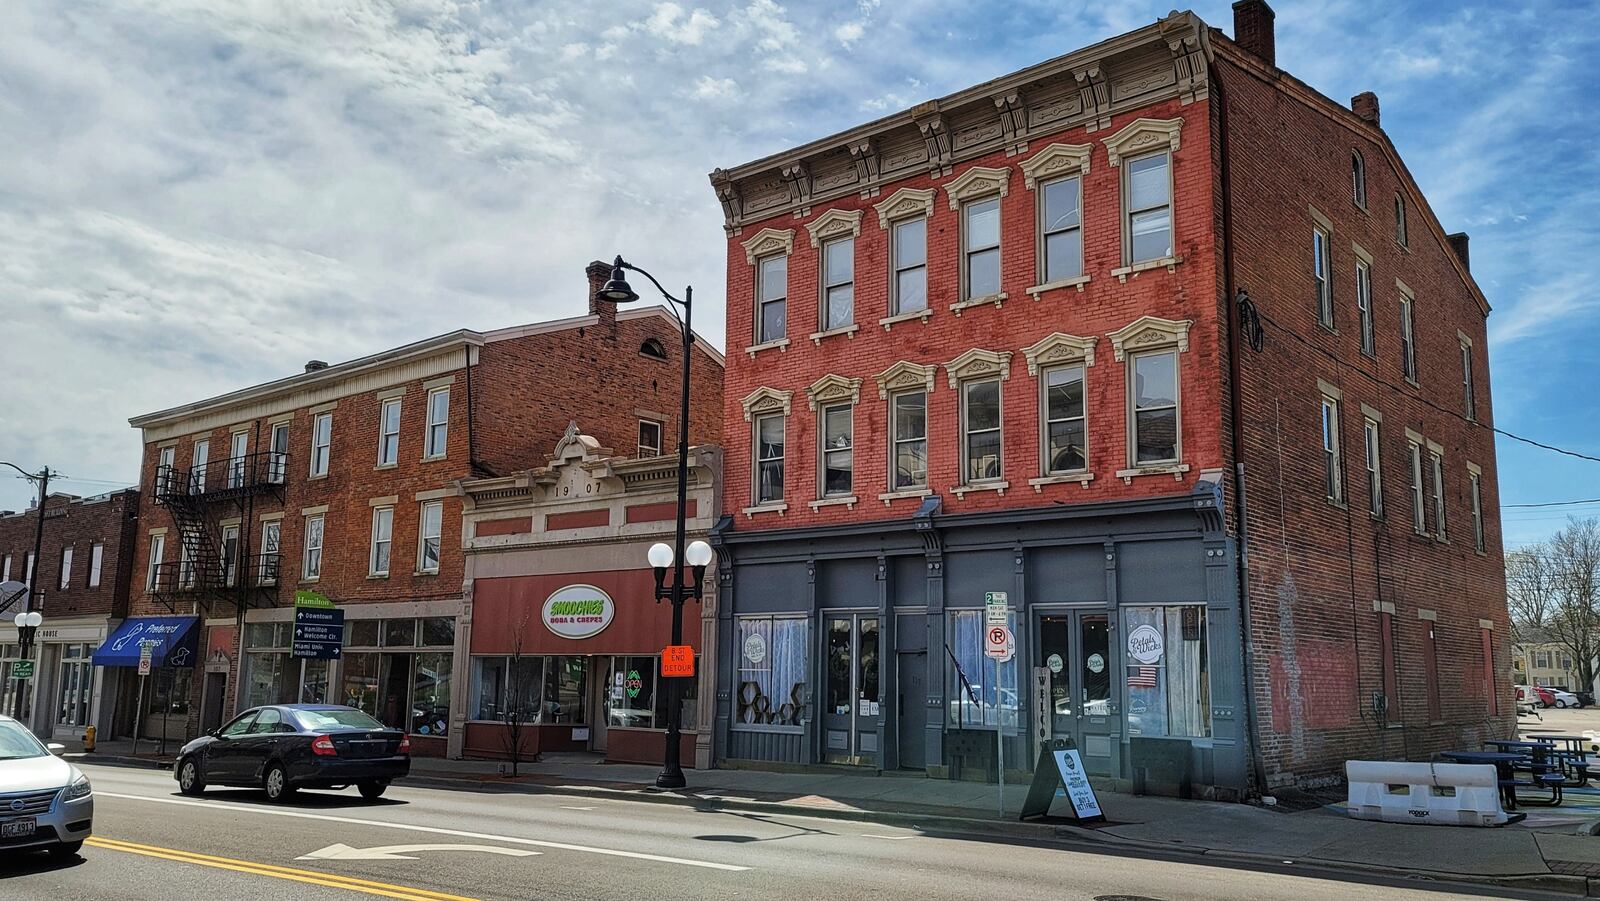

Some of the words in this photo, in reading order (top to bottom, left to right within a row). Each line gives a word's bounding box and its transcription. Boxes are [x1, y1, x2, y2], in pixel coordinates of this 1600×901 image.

[297, 596, 330, 606] Hamilton
[550, 600, 605, 617] SMOOCHIES
[305, 612, 333, 620] Downtown
[550, 616, 568, 624] BOBA
[569, 616, 575, 624] &
[576, 616, 603, 624] CREPES
[42, 630, 58, 638] HOUSE
[144, 624, 181, 634] Preferred
[1130, 634, 1155, 648] Petals
[1138, 642, 1162, 654] Wicks
[671, 654, 685, 662] END
[664, 664, 692, 672] DETOUR
[625, 679, 643, 689] OPEN
